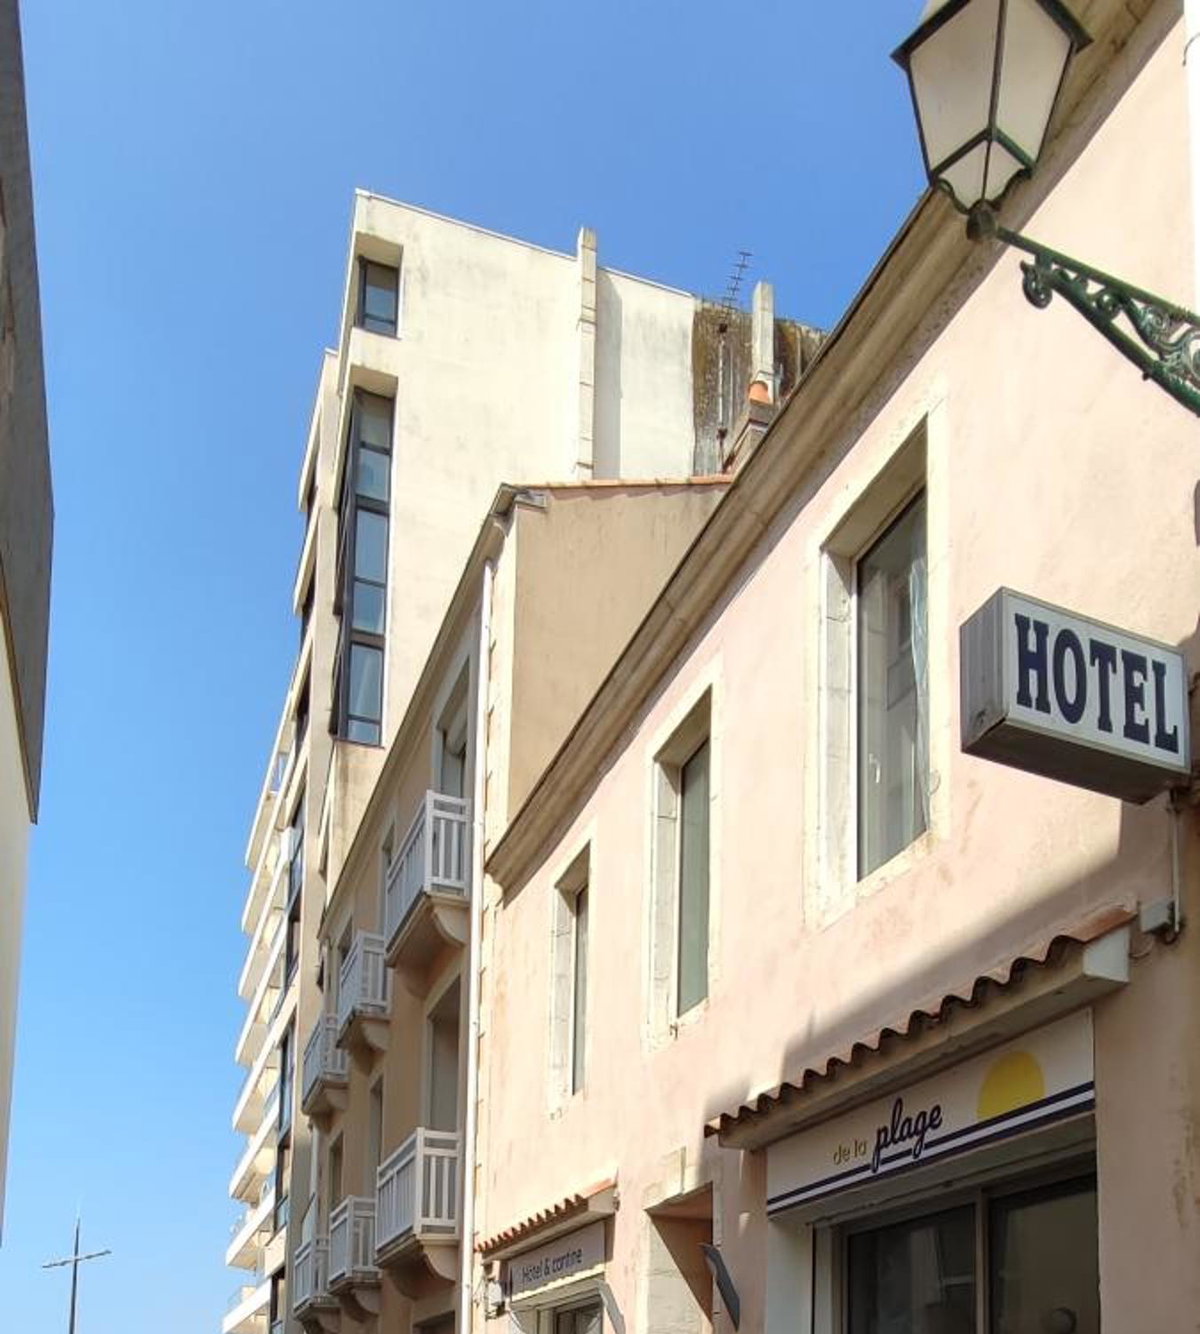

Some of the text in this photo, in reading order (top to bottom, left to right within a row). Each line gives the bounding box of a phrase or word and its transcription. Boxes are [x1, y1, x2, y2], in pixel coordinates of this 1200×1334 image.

[1014, 612, 1180, 755] HOTEL
[833, 1098, 943, 1173] de la plage
[544, 1258, 551, 1277] &
